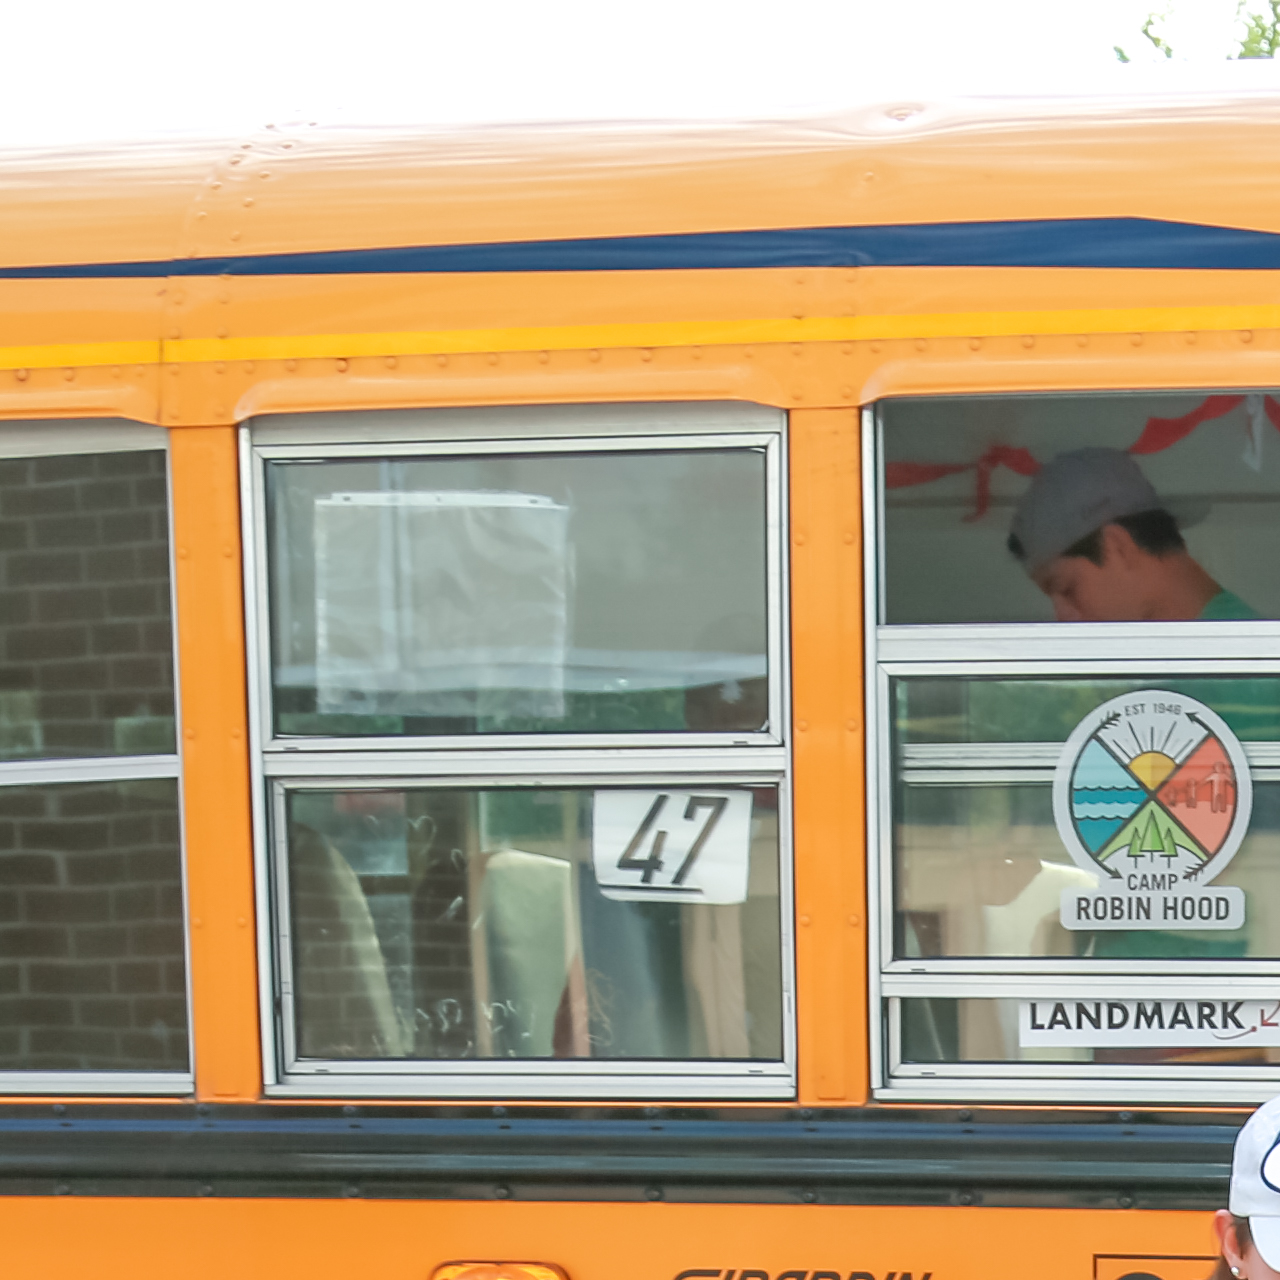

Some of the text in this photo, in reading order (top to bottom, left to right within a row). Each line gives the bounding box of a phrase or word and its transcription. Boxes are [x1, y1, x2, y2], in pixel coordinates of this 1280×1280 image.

[1124, 702, 1146, 716] EST
[616, 794, 729, 884] 47
[1127, 873, 1179, 892] CAMP
[1076, 896, 1230, 921] ROBIN HOOD
[1030, 1001, 1245, 1030] LANDMARK
